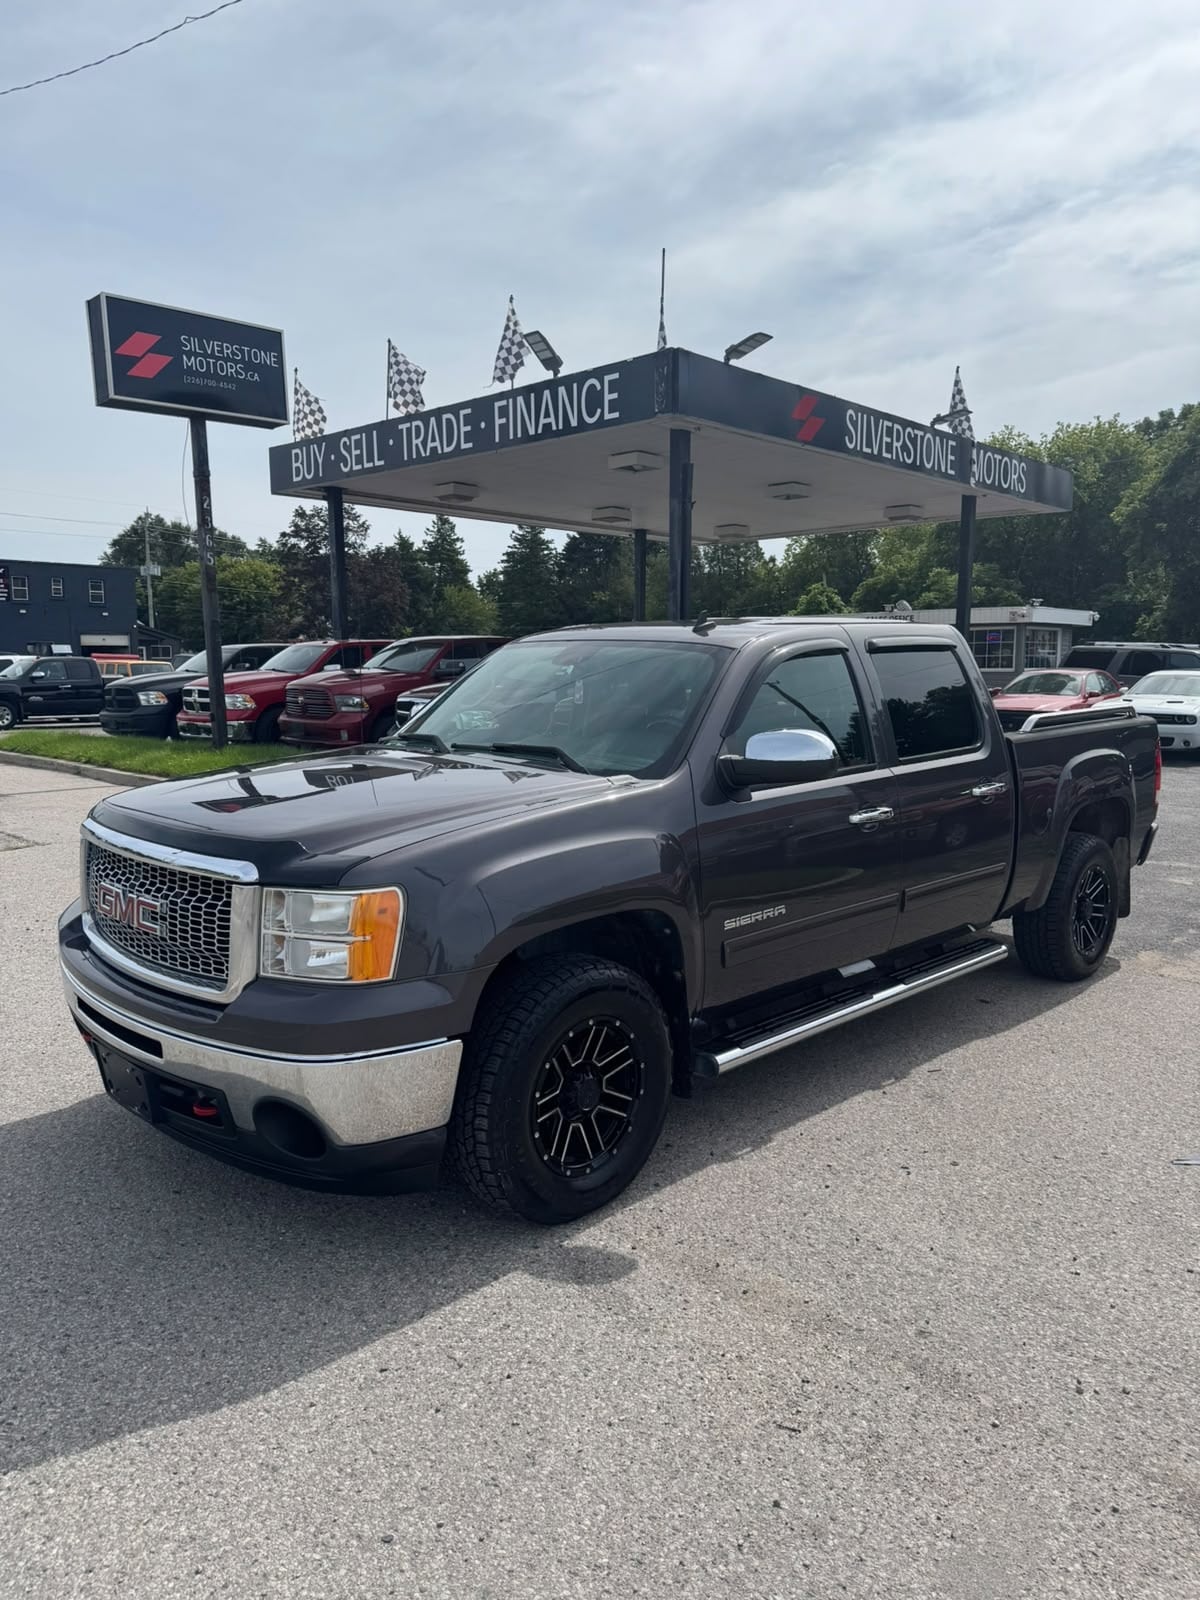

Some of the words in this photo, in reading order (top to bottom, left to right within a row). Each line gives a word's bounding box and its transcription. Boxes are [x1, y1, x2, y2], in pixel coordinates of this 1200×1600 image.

[180, 335, 279, 368] SILVERSTONE
[182, 354, 260, 382] MOTORS.CA
[292, 442, 326, 482] BUY
[340, 430, 385, 473] SELL
[398, 408, 473, 461] TRADE
[494, 372, 620, 443] FINANCE
[845, 409, 956, 475] SILVERSTONE
[98, 881, 162, 936] GMC
[723, 904, 787, 931] SIERRA
